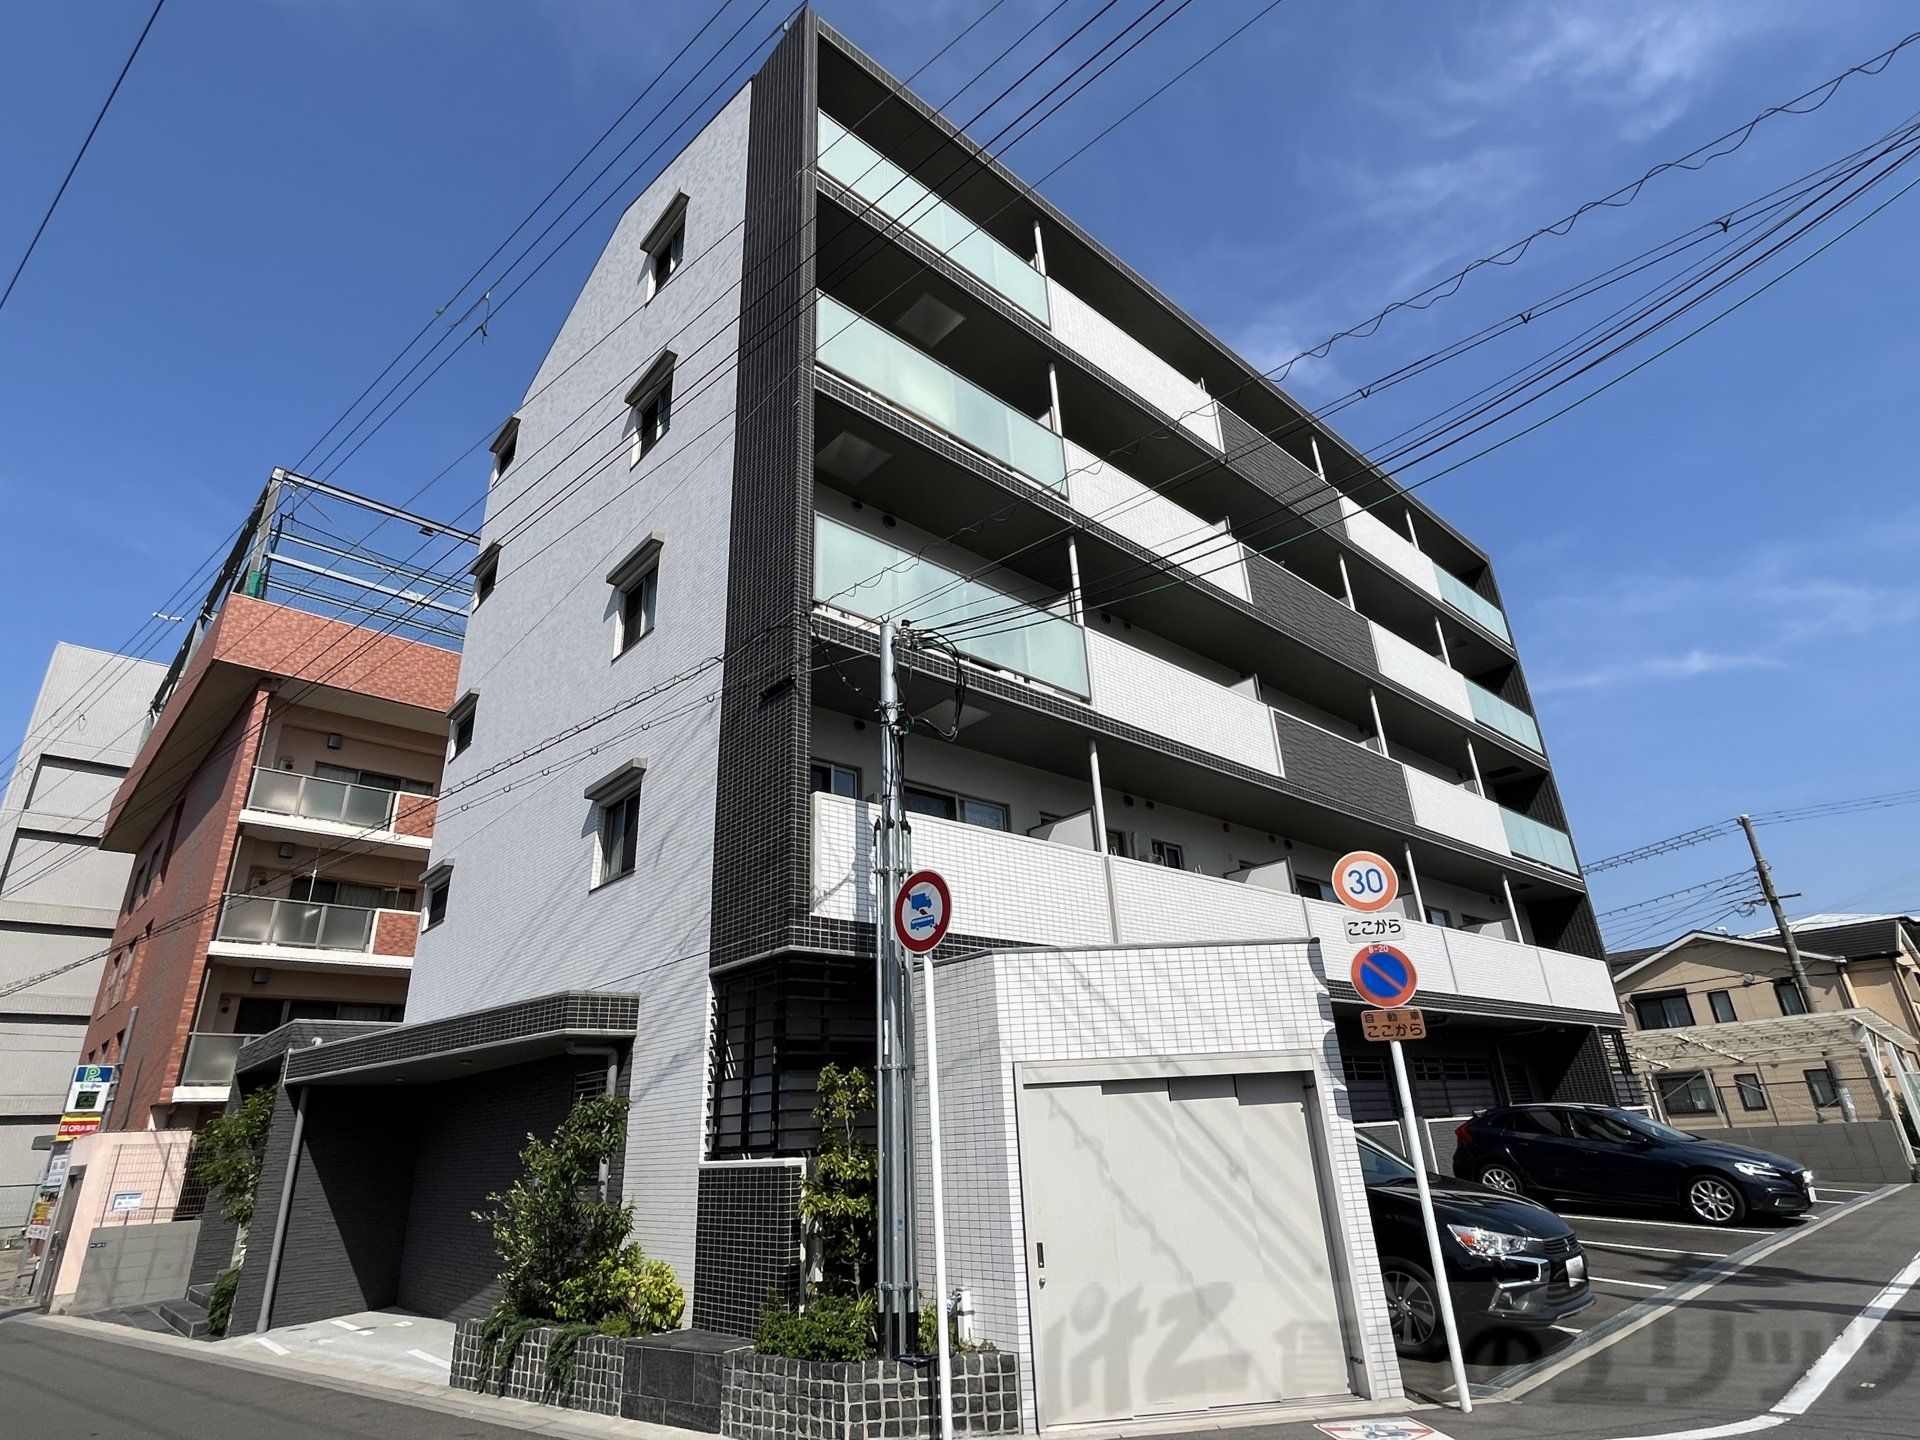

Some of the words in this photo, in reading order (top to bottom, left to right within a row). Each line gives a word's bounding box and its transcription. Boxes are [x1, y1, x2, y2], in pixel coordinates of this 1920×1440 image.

[1348, 868, 1384, 895] 30
[1348, 919, 1401, 936] ここから
[1367, 1023, 1423, 1038] ここから
